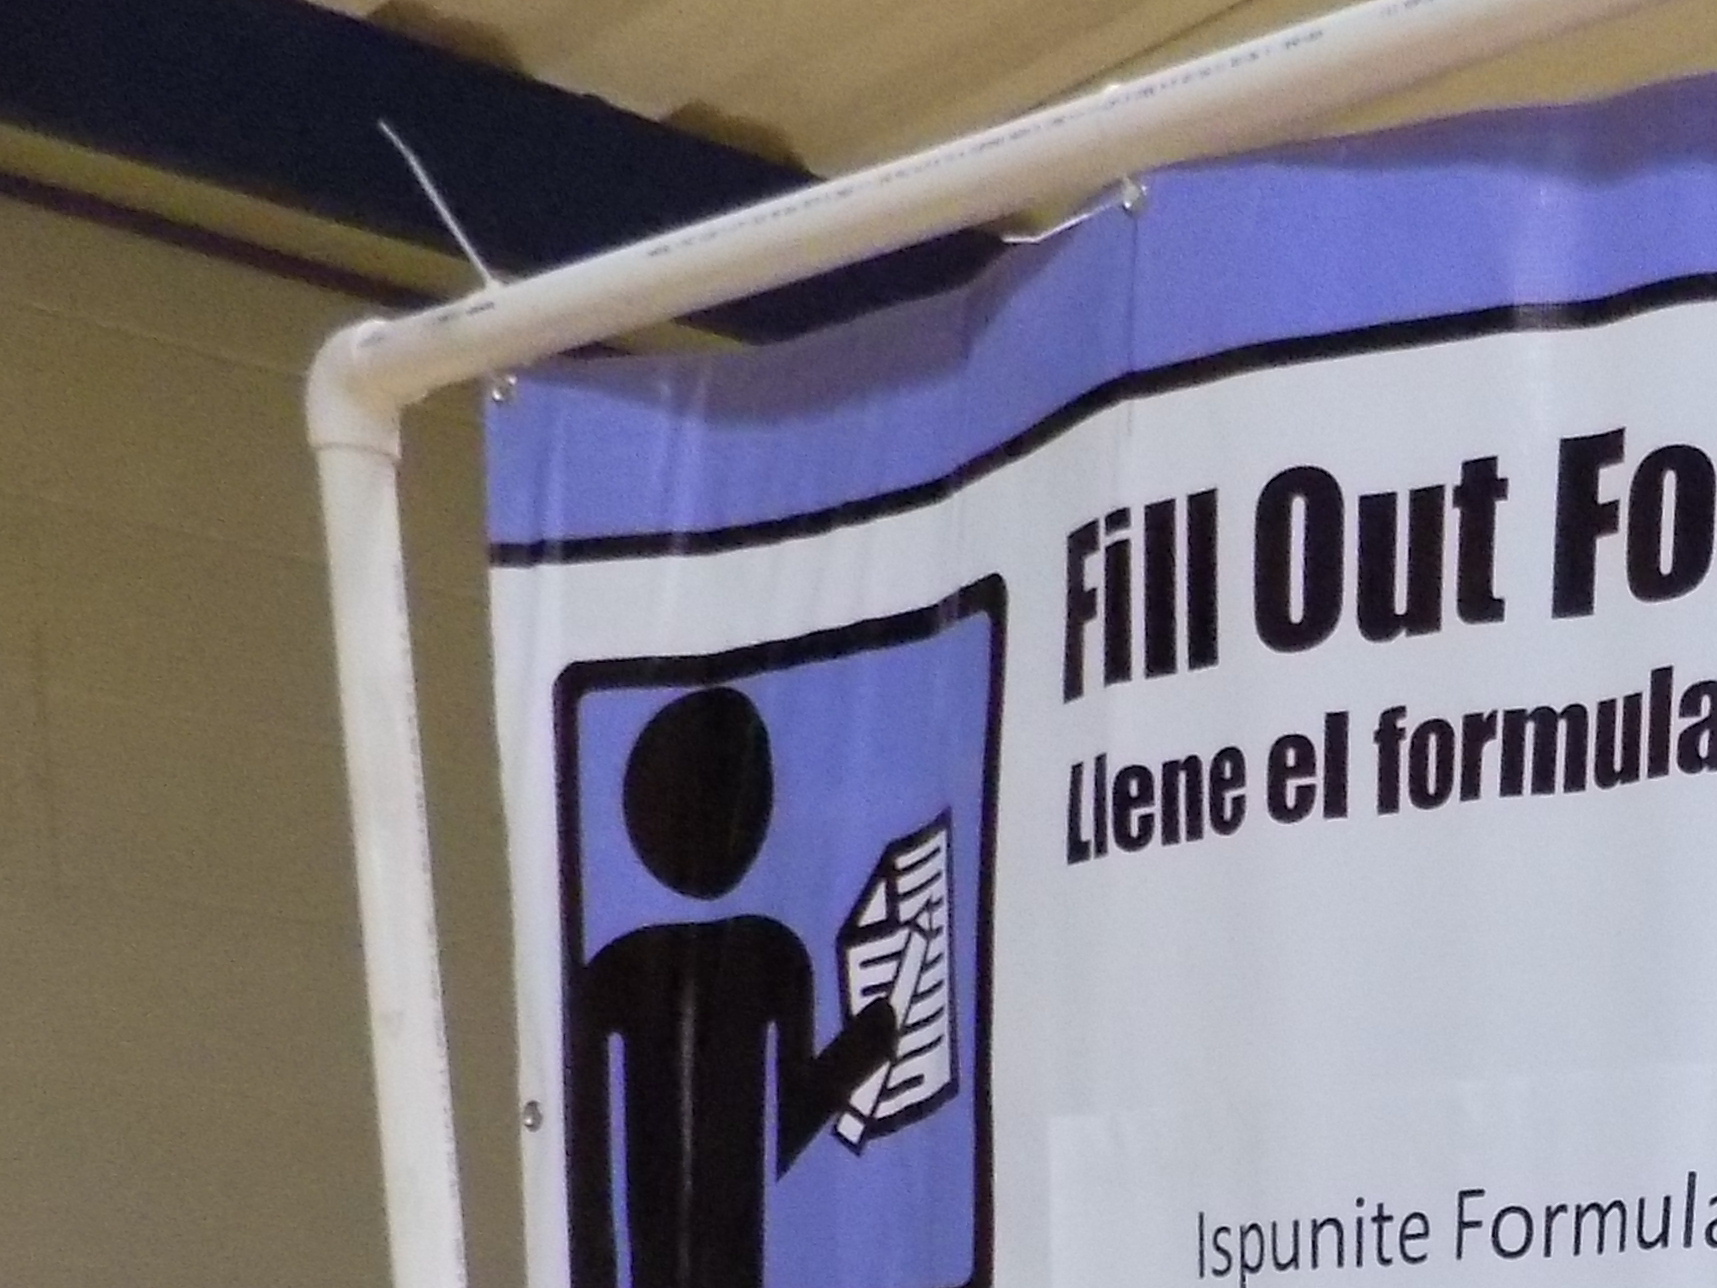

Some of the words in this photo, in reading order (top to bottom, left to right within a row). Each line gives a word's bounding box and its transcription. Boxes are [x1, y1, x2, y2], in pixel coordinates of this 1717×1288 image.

[1062, 487, 1219, 704] Fill
[1254, 455, 1509, 654] Out
[1066, 745, 1247, 866] Llene
[1266, 710, 1349, 824] el
